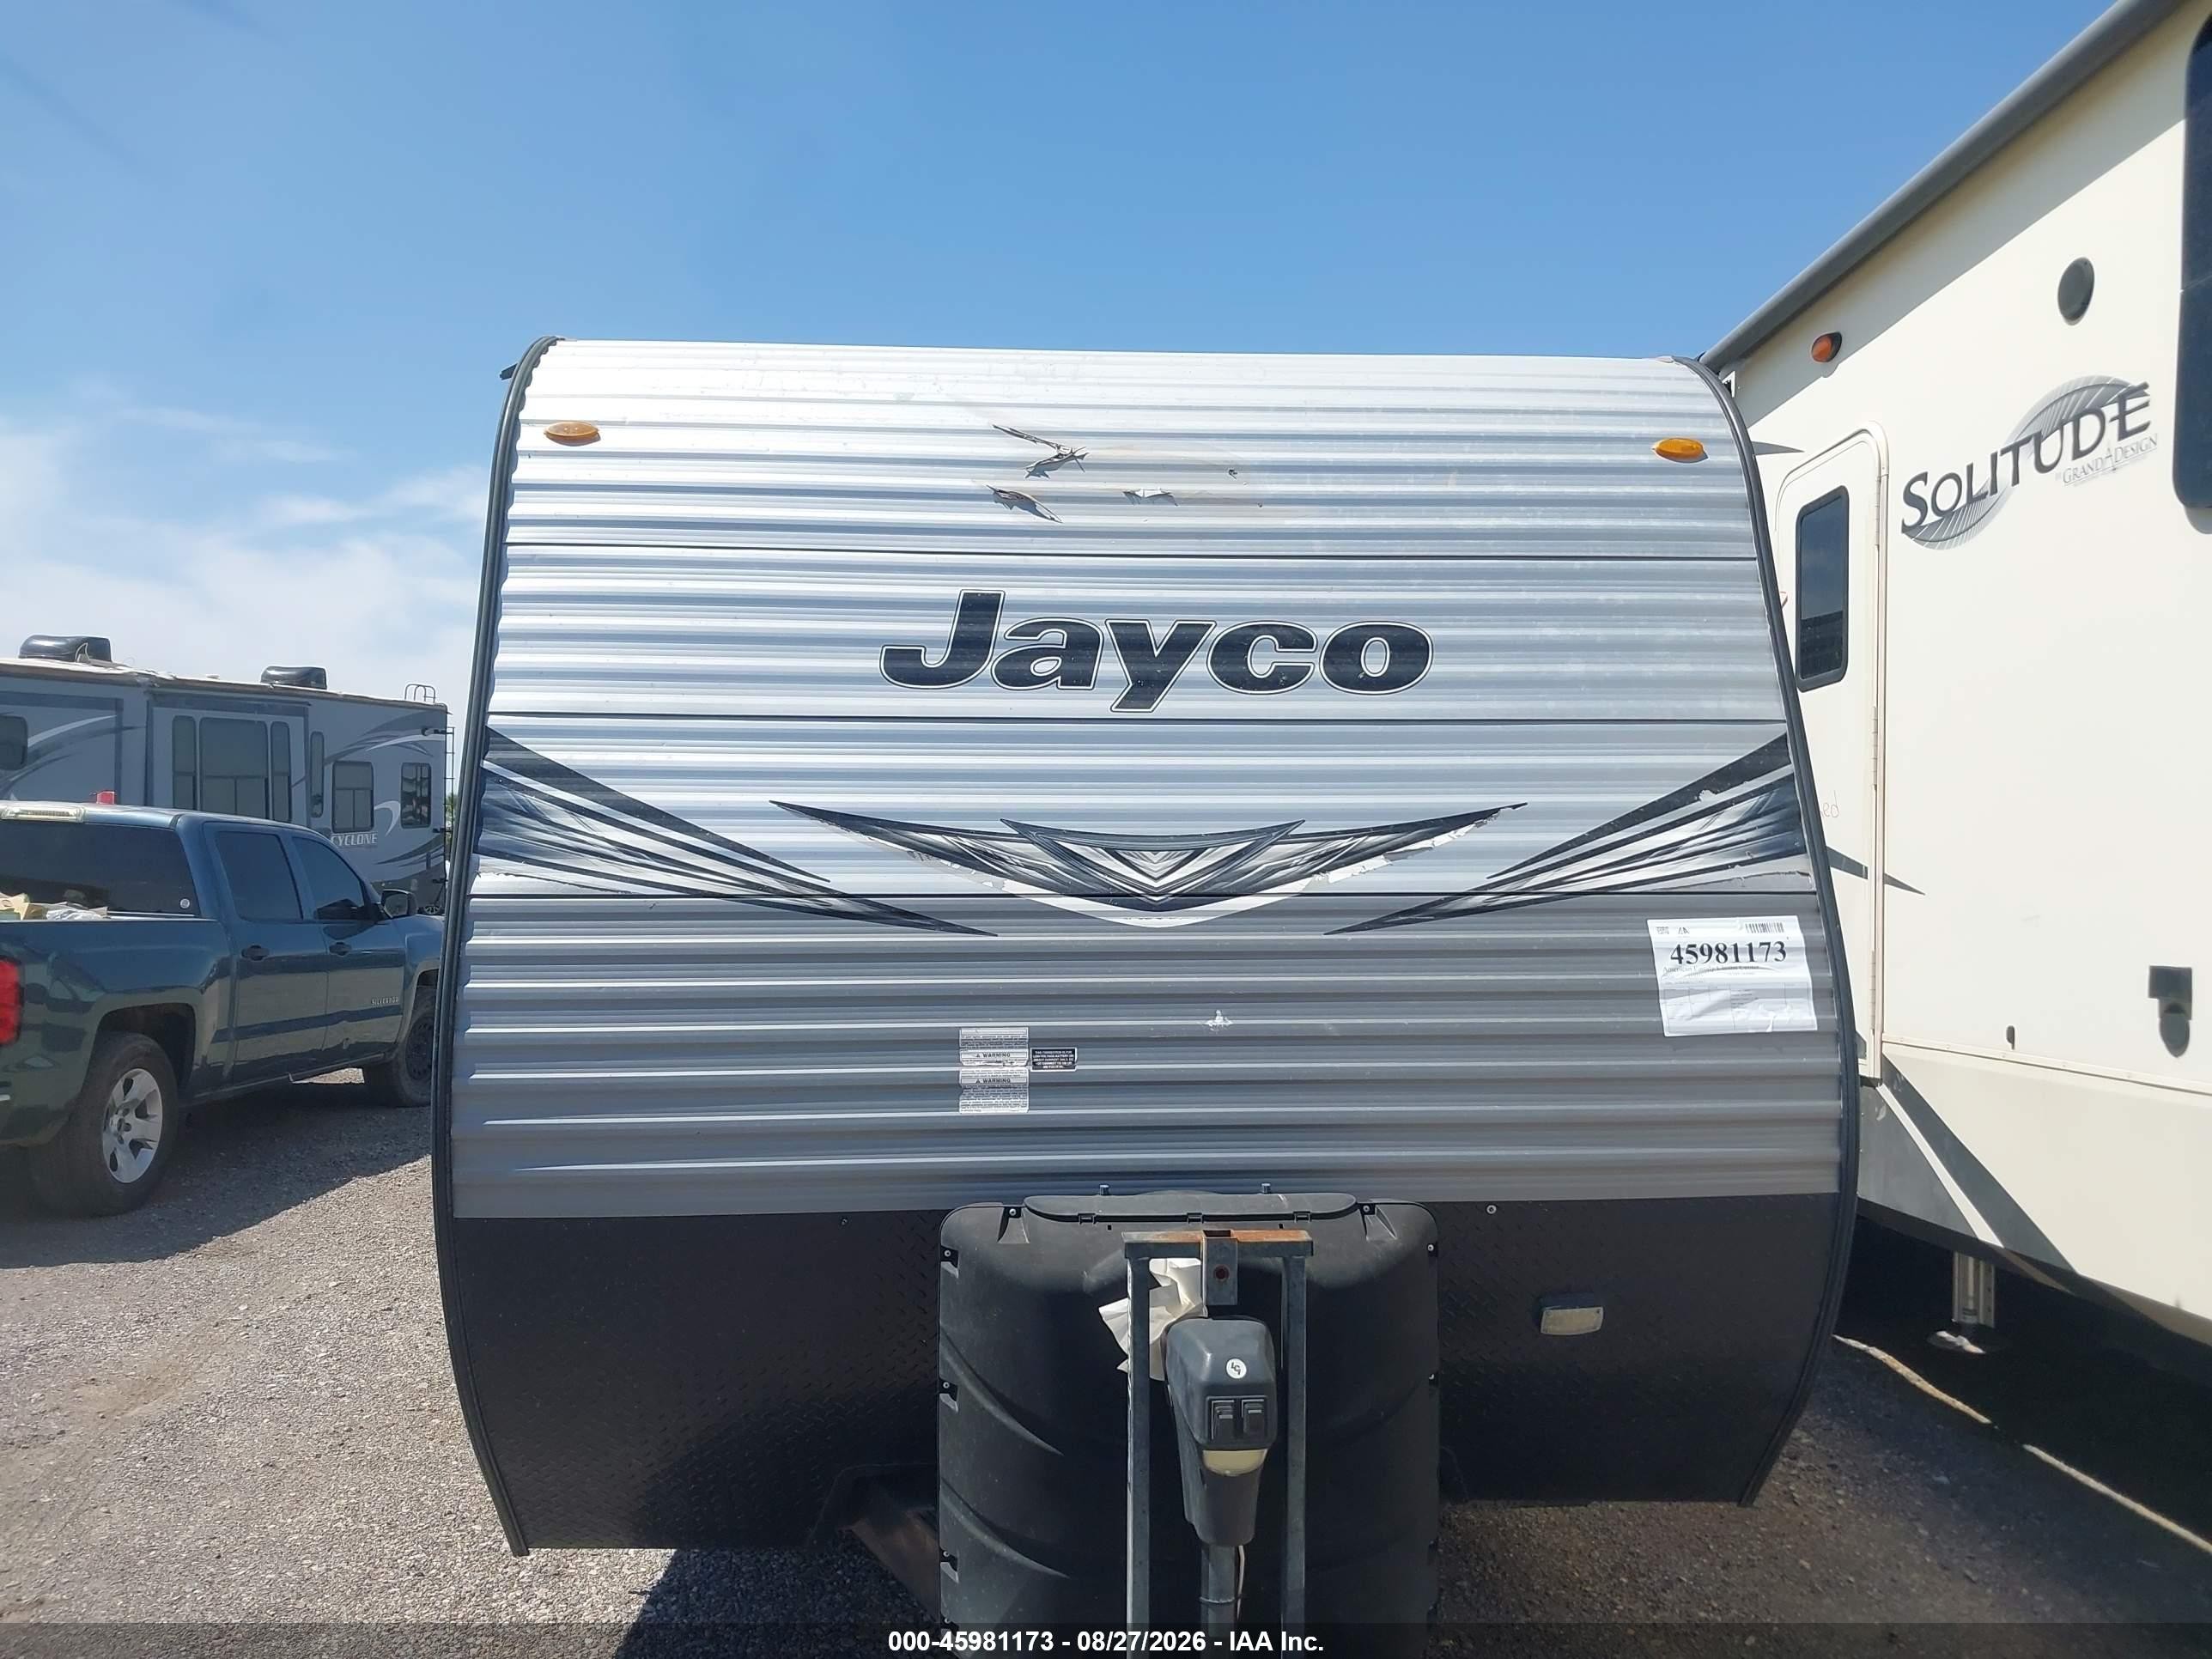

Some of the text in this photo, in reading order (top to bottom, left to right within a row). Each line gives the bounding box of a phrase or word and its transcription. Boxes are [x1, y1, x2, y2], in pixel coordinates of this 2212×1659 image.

[1900, 381, 2151, 533] SOLITUDE
[2063, 434, 2157, 483] GRAND DESIGN
[878, 589, 1434, 714] Jayco
[331, 833, 378, 846] CYCLONE
[1670, 941, 1787, 964] 45981173
